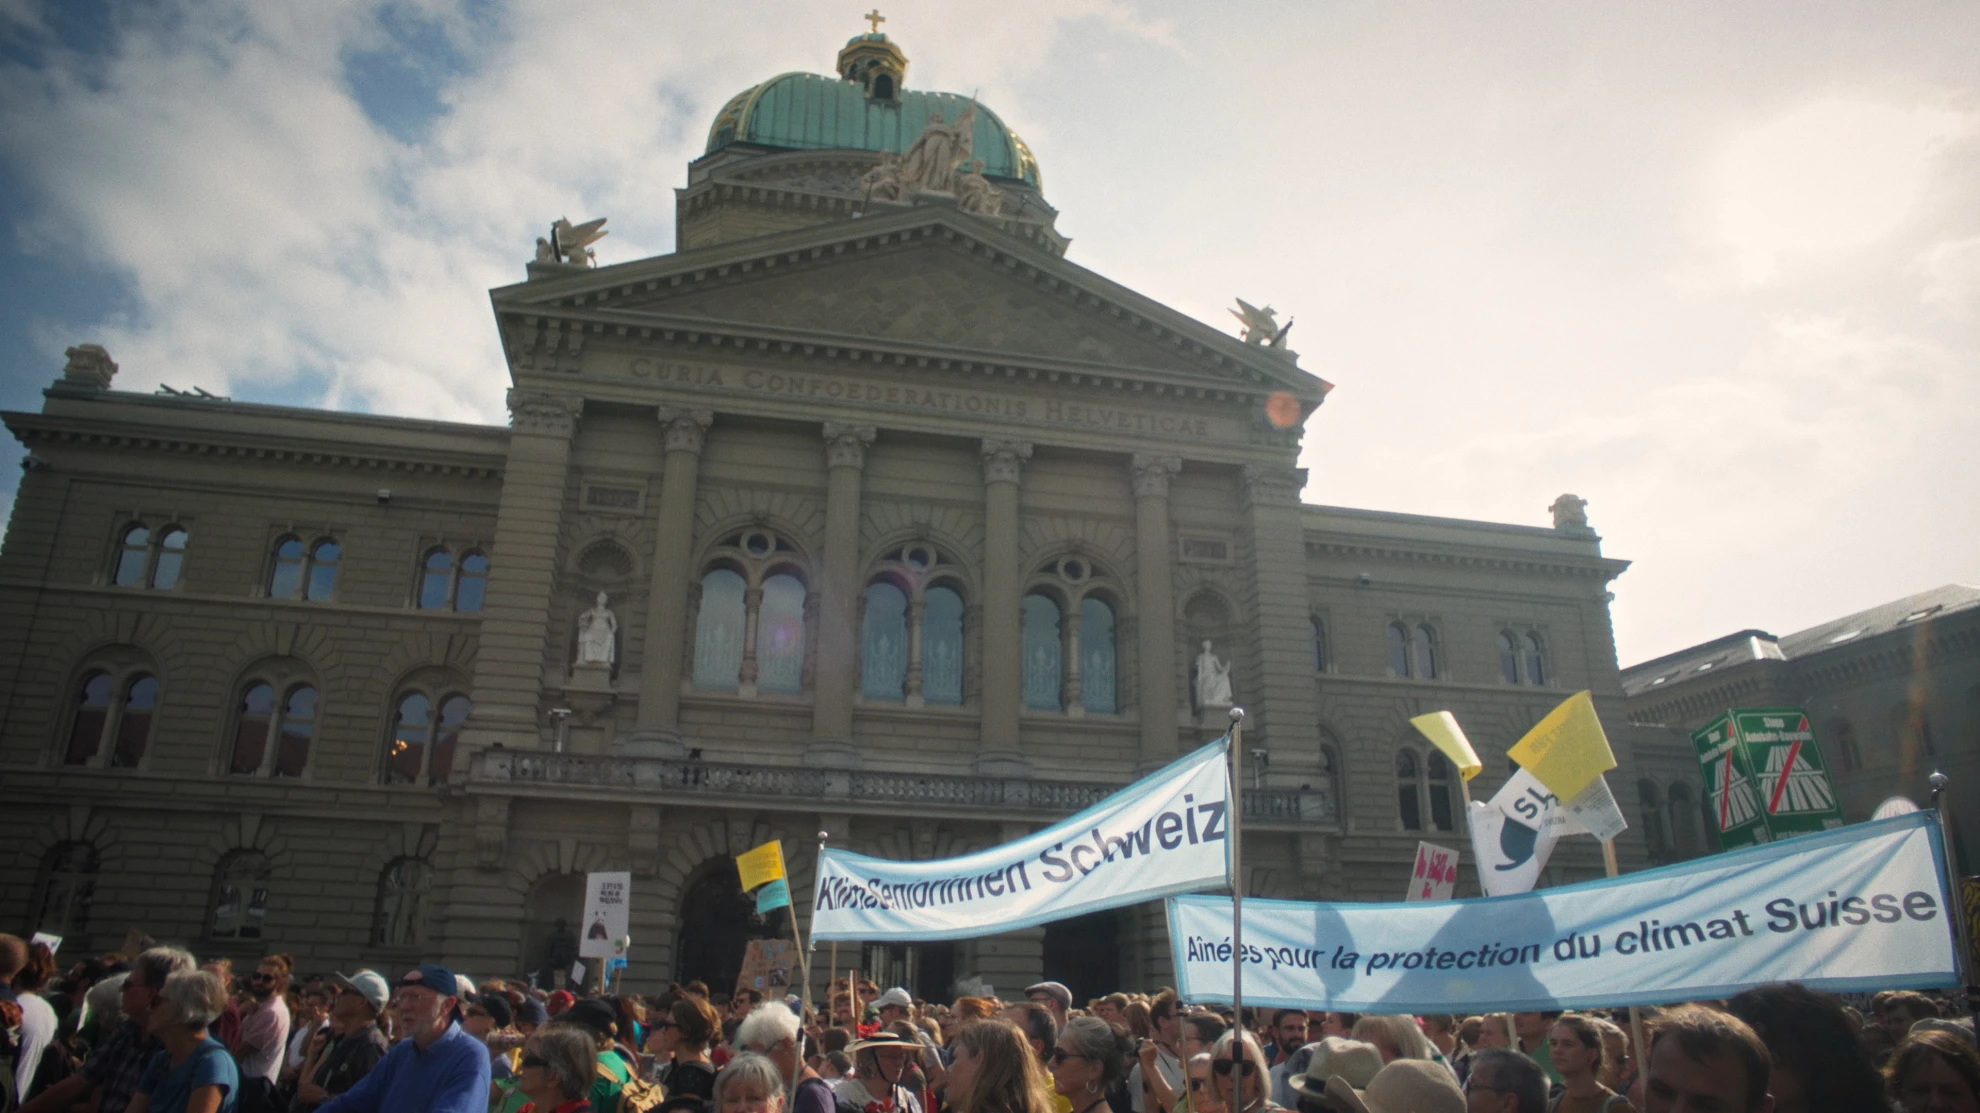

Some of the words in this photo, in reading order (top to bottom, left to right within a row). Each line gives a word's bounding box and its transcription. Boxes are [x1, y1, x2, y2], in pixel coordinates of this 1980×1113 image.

[630, 357, 723, 386] CURIA
[743, 369, 1027, 417] CONFOEDERATIONIS
[1046, 398, 1208, 436] HELVETICAE
[1039, 793, 1225, 883] Schweiz
[1263, 946, 1325, 971] pour
[1331, 945, 1360, 969] la
[1366, 942, 1541, 976] protection
[1553, 931, 1600, 961] du
[1615, 909, 1755, 956] climat
[1765, 890, 1938, 934] Suisse
